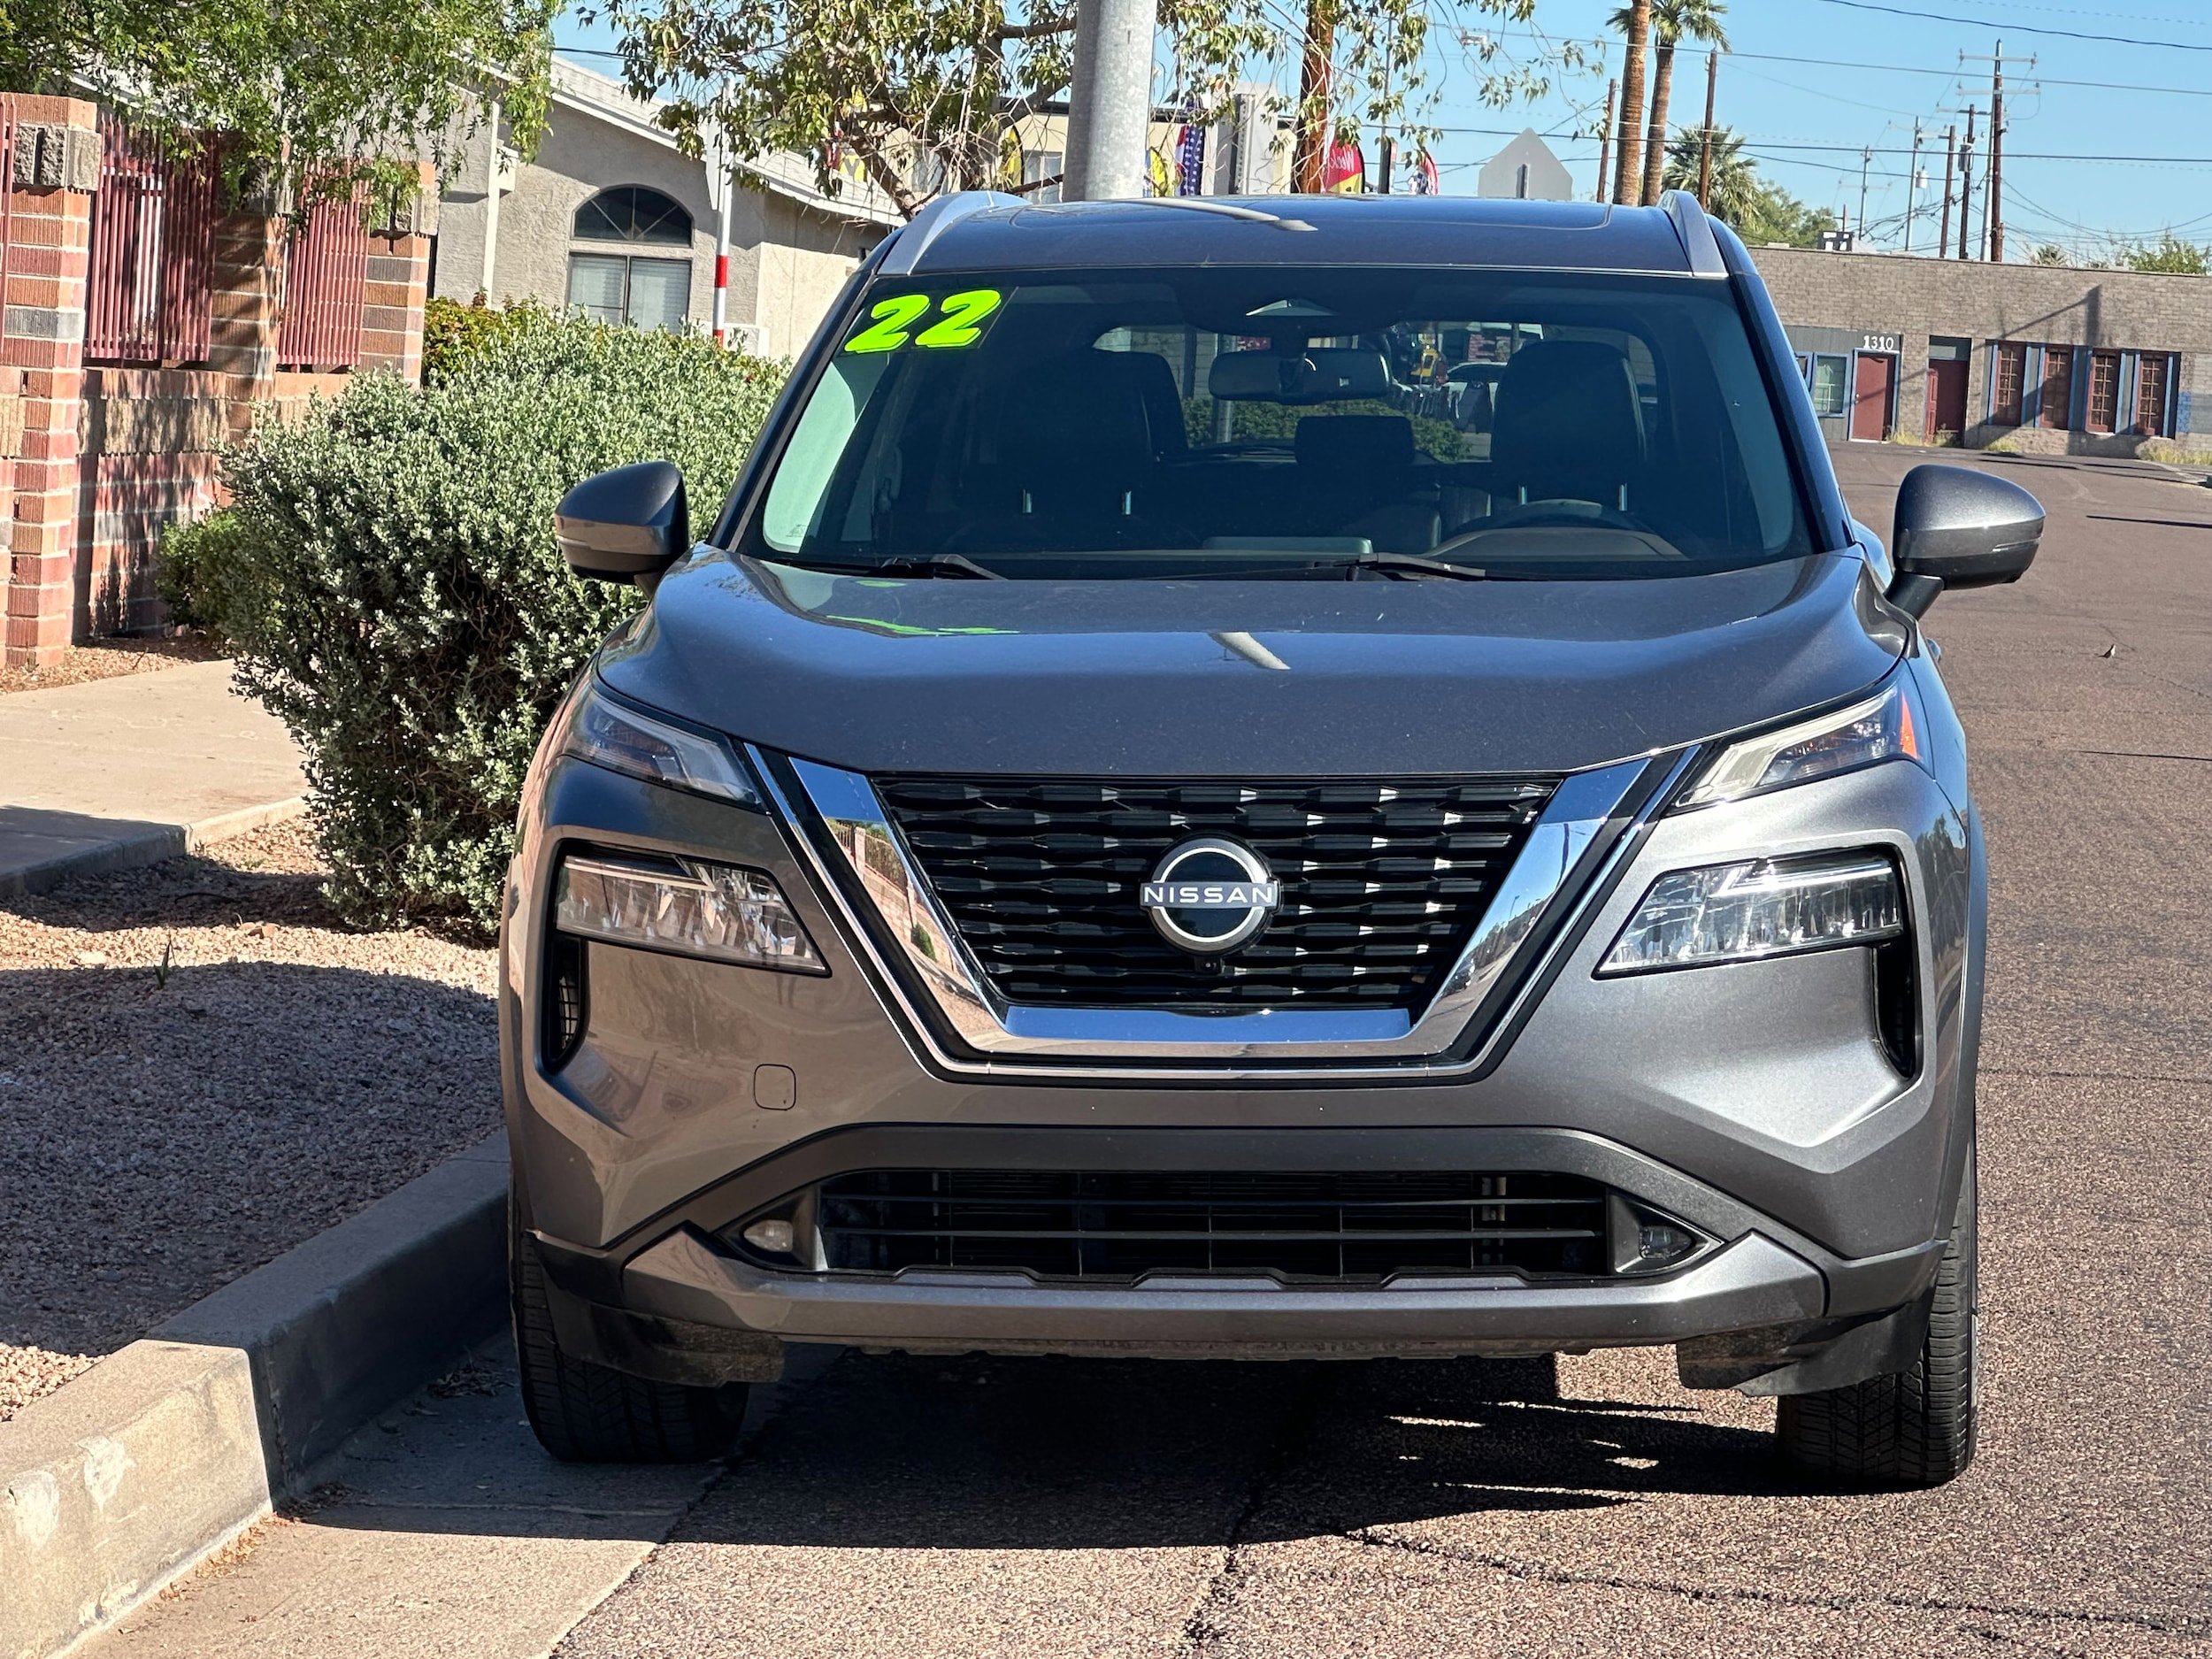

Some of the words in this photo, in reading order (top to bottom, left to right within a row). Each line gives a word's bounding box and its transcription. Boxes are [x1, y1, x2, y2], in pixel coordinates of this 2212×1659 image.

[844, 289, 1002, 354] 22
[1863, 335, 1894, 350] 1310
[1144, 887, 1272, 903] NISSAN
